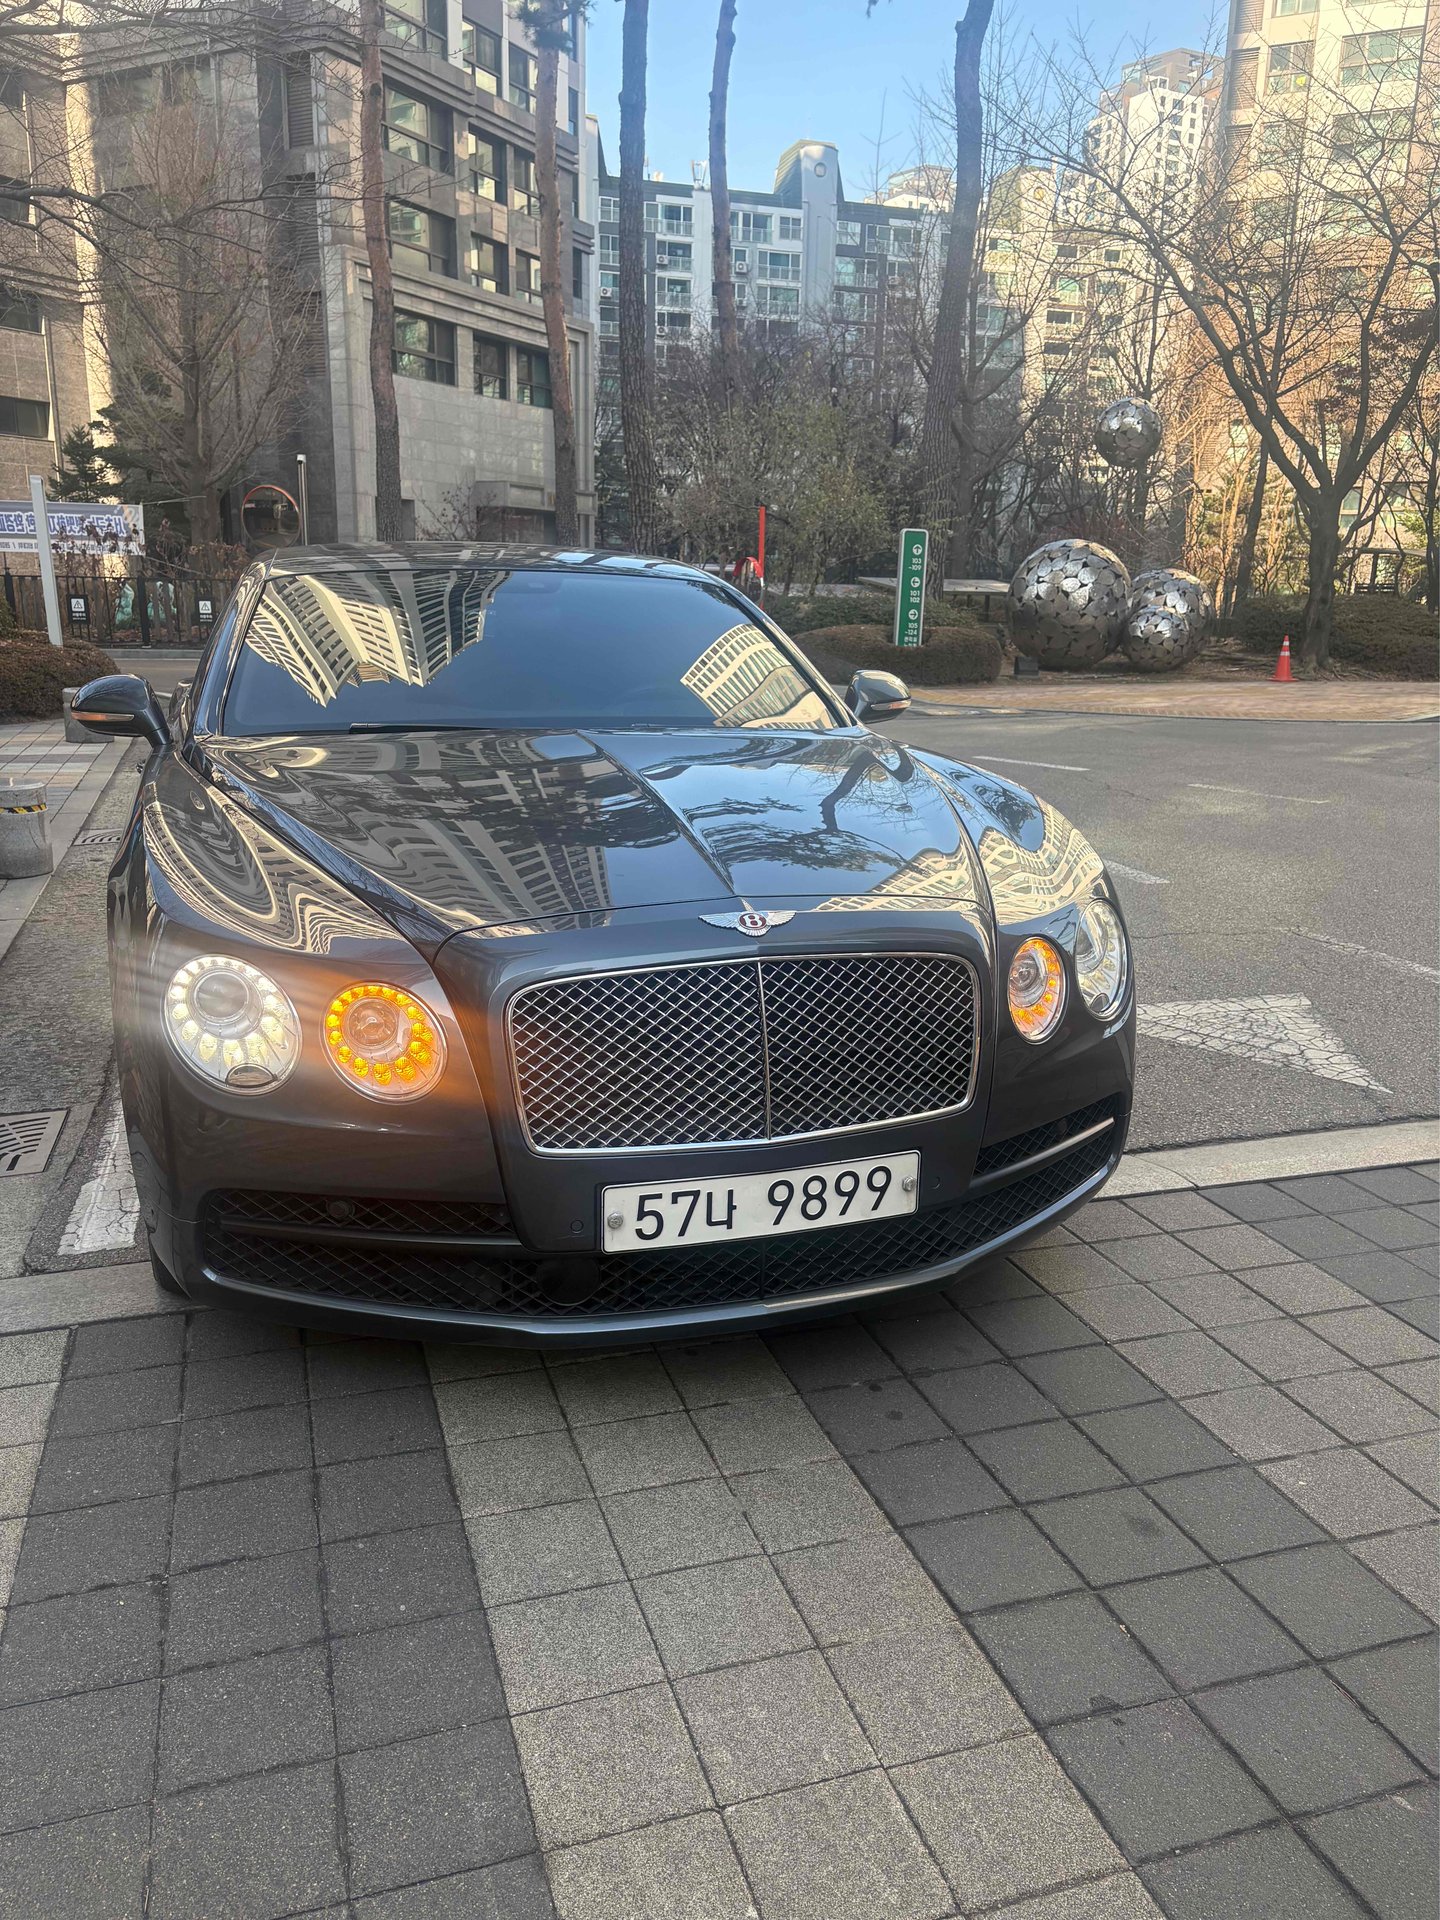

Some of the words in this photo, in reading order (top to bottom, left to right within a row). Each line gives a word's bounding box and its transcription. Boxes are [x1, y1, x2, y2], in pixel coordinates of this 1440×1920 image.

[743, 914, 763, 926] B
[635, 1189, 737, 1241] 57나
[767, 1165, 893, 1227] 9899
